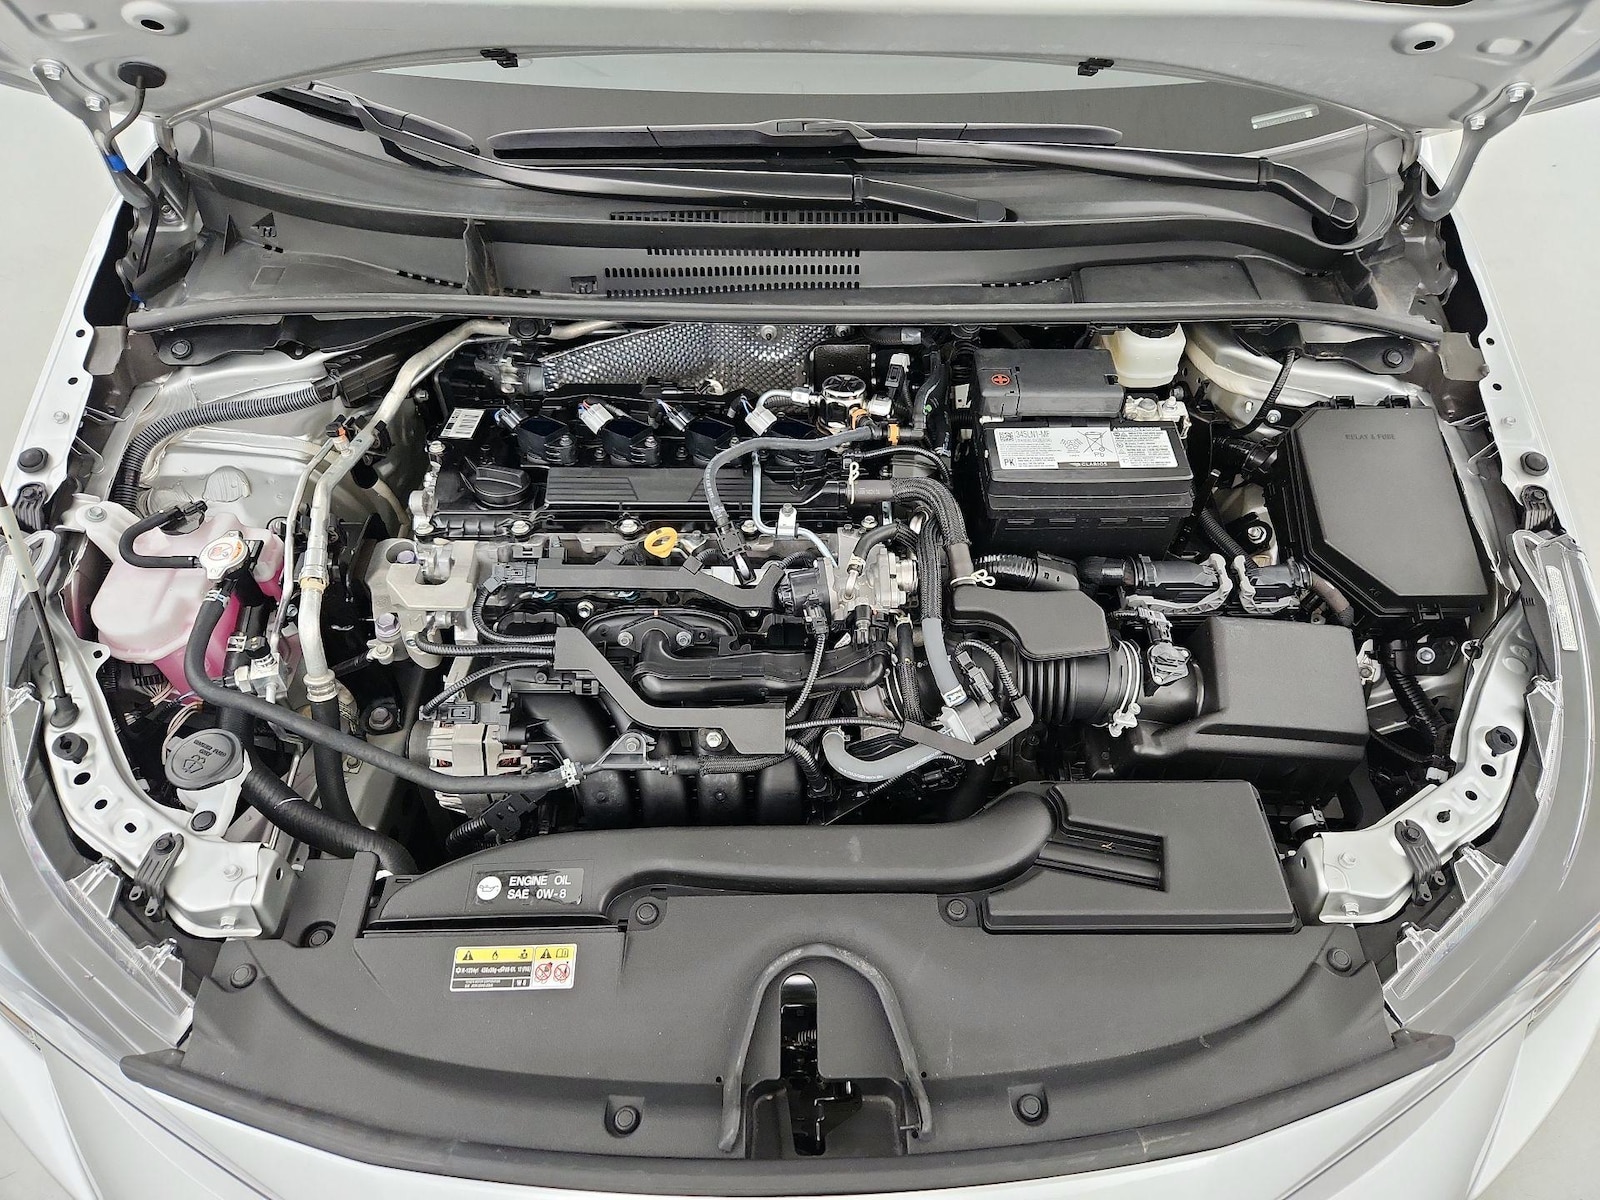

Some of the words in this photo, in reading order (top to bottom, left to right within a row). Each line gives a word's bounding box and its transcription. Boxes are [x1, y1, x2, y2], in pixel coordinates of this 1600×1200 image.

[1003, 458, 1016, 467] PK
[509, 875, 549, 887] ENGINE
[554, 874, 571, 885] OIL
[507, 889, 530, 900] SAE
[536, 888, 567, 900] 0W-8
